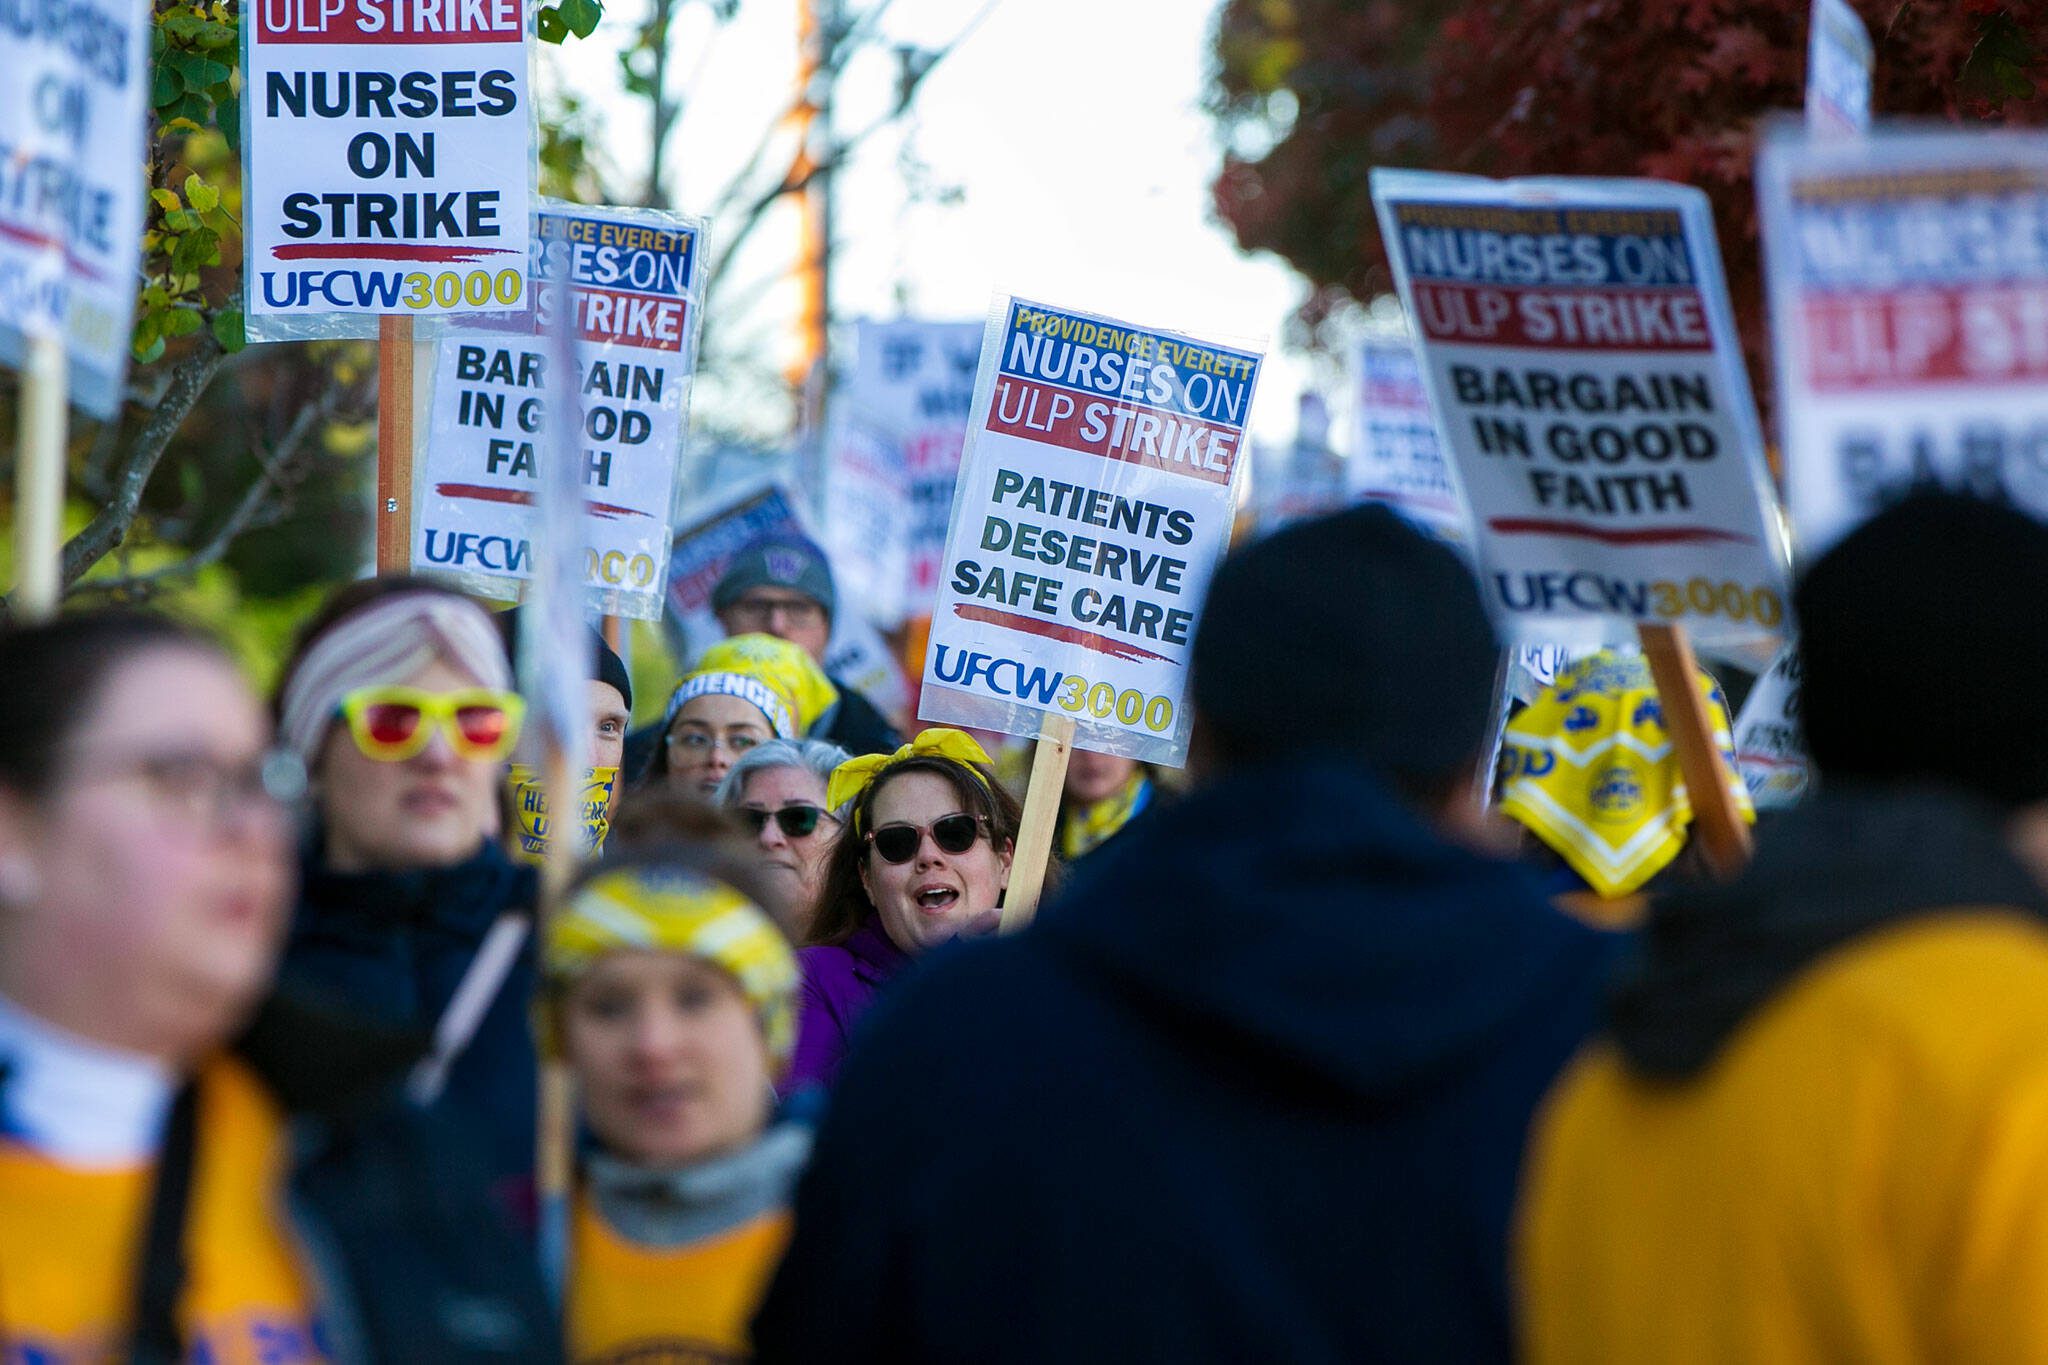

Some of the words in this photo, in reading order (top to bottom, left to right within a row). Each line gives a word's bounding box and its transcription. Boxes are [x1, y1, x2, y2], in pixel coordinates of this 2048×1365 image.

[264, 0, 347, 33] ULP
[355, 0, 518, 32] STRIKE
[266, 69, 518, 118] NURSES
[347, 132, 435, 179] ON
[281, 190, 500, 239] STRIKE
[600, 225, 692, 255] EVERETT
[529, 239, 621, 284] RSES
[629, 250, 686, 293] ON
[1406, 226, 1610, 283] NURSES
[1613, 233, 1691, 284] ON
[260, 269, 522, 309] UFCW3000
[1418, 287, 1511, 338] ULP
[1518, 293, 1708, 345] STRIKE
[1015, 308, 1155, 359] PROVIDENCE
[1157, 341, 1256, 381] EVERETT
[456, 345, 664, 403] BARAIN
[1008, 332, 1176, 405] NURSES
[1183, 373, 1245, 421] ON
[1450, 364, 1713, 412] BARGAIN
[458, 390, 505, 429] IN
[517, 398, 652, 445] GOD
[998, 382, 1075, 433] ULP
[1080, 402, 1236, 473] STRIKE
[1474, 416, 1532, 460] IN
[1545, 420, 1717, 466] GOOD
[487, 438, 612, 487] FAH
[992, 468, 1196, 547] PATIENTS
[1530, 470, 1691, 515] FAITH
[424, 528, 655, 588] UFCW00
[980, 515, 1187, 595] DESERVE
[951, 559, 1064, 616] SAFE
[1070, 587, 1194, 647] CARE
[934, 643, 1174, 732] UFCW3000
